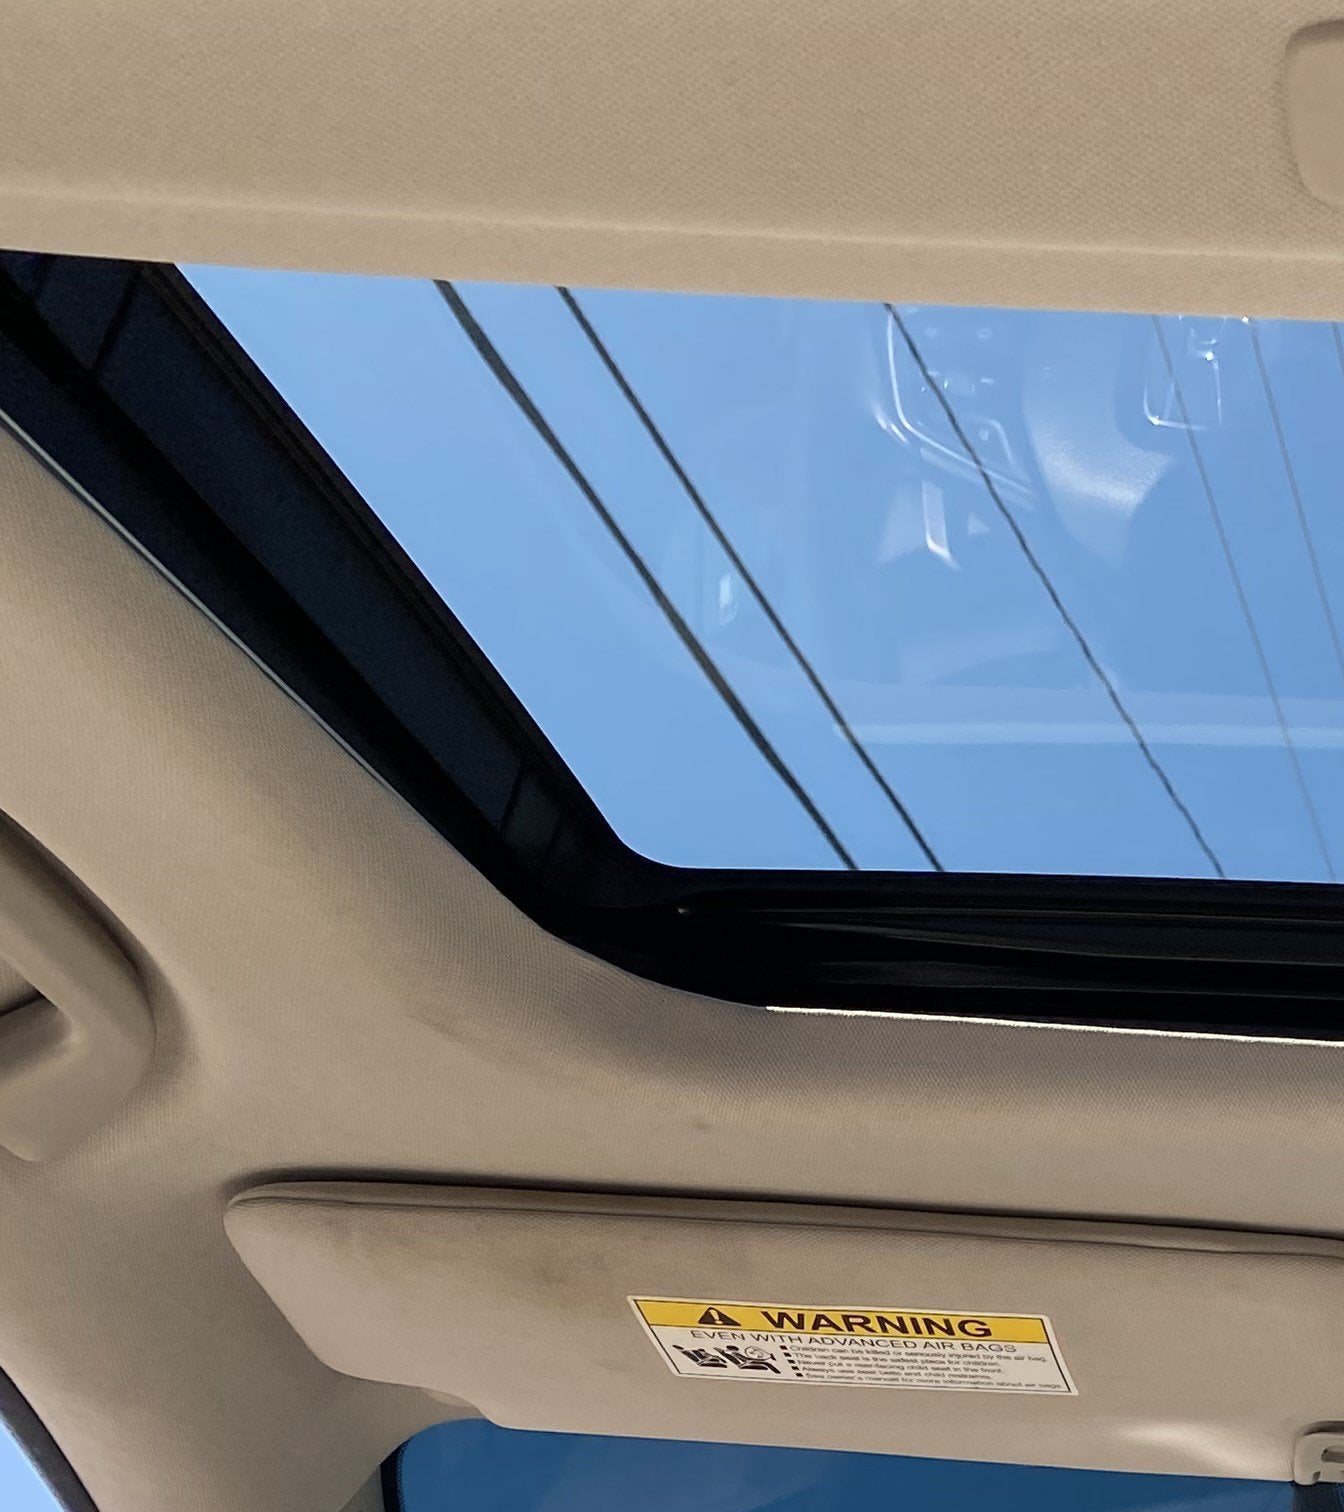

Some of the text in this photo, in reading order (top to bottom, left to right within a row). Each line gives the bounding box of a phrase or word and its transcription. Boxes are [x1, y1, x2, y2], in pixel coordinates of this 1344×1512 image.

[761, 1310, 992, 1338] WARNING
[690, 1330, 1017, 1353] EVEN WITH ADVANCED AIR BAGS
